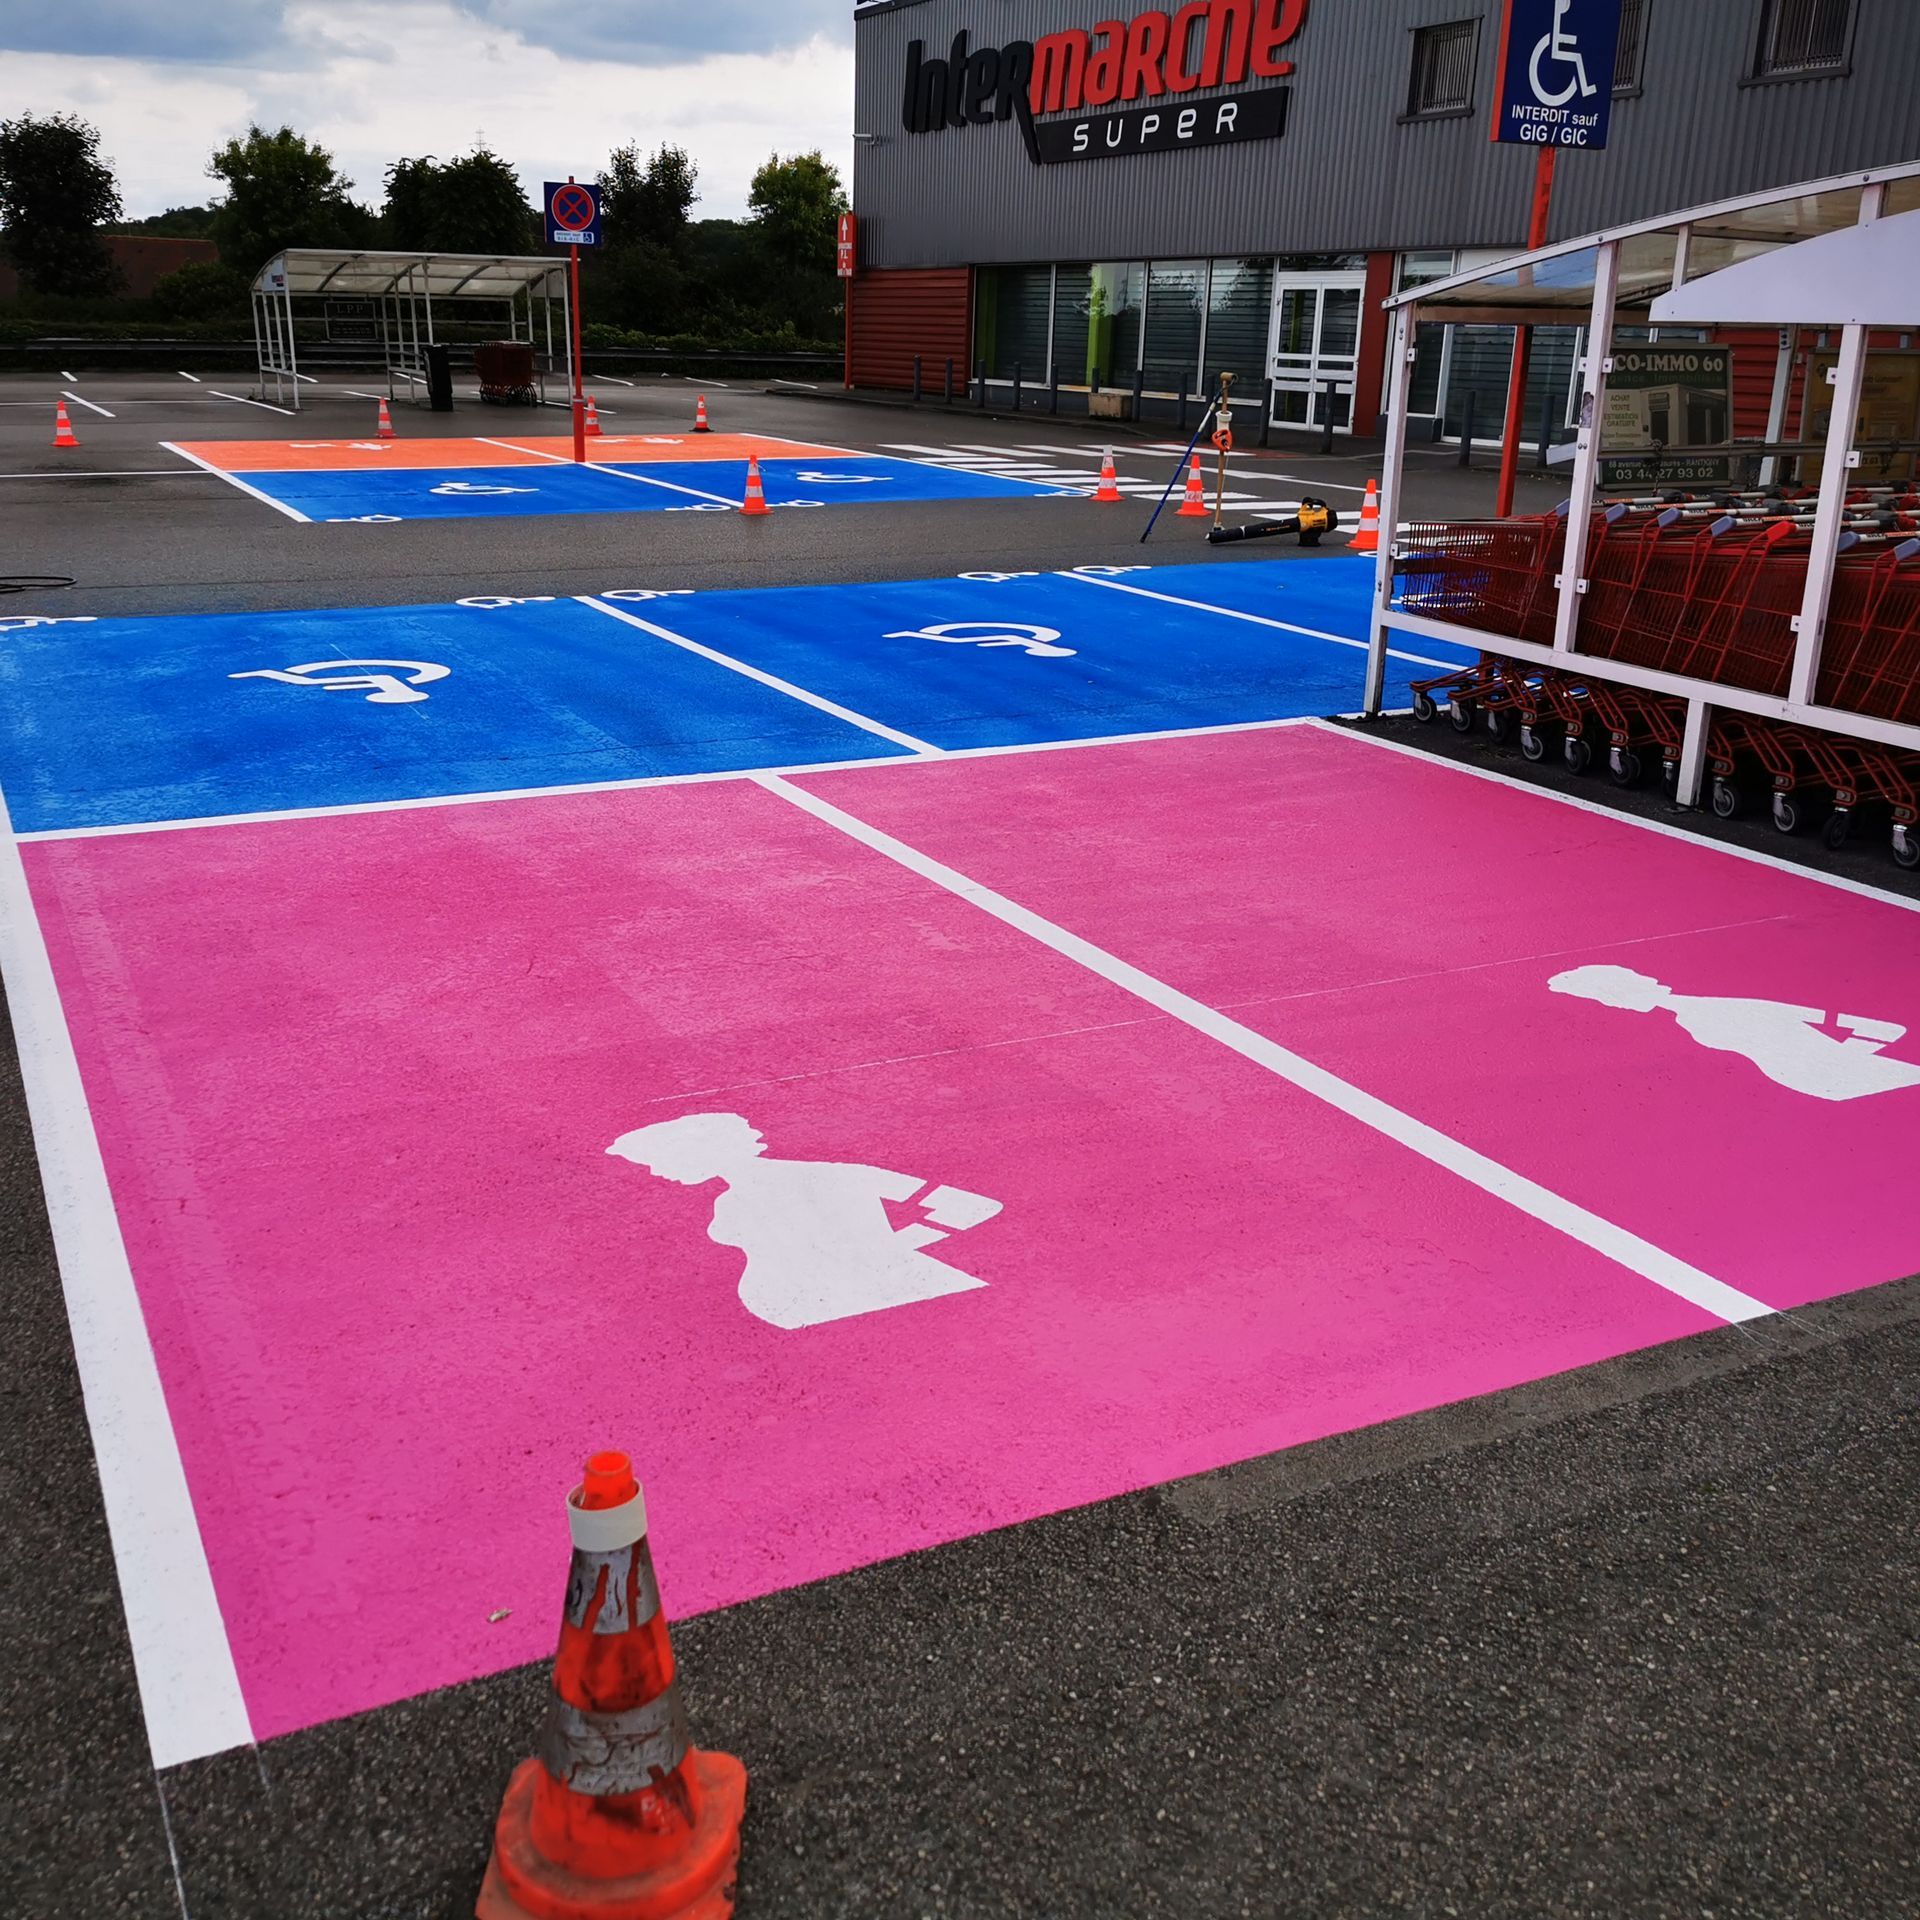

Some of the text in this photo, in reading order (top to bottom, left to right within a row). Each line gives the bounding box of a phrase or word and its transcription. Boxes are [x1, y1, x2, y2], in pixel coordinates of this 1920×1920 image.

[1512, 104, 1599, 126] INTERDIT sauf
[1520, 123, 1548, 142] GIG
[1560, 127, 1588, 146] GIC
[1614, 354, 1724, 372] CO-IMMO 60
[1611, 394, 1630, 402] ACHAT
[1615, 468, 1633, 480] 03
[1659, 467, 1674, 479] 27
[1677, 467, 1694, 479] 93
[1697, 466, 1714, 478] 02
